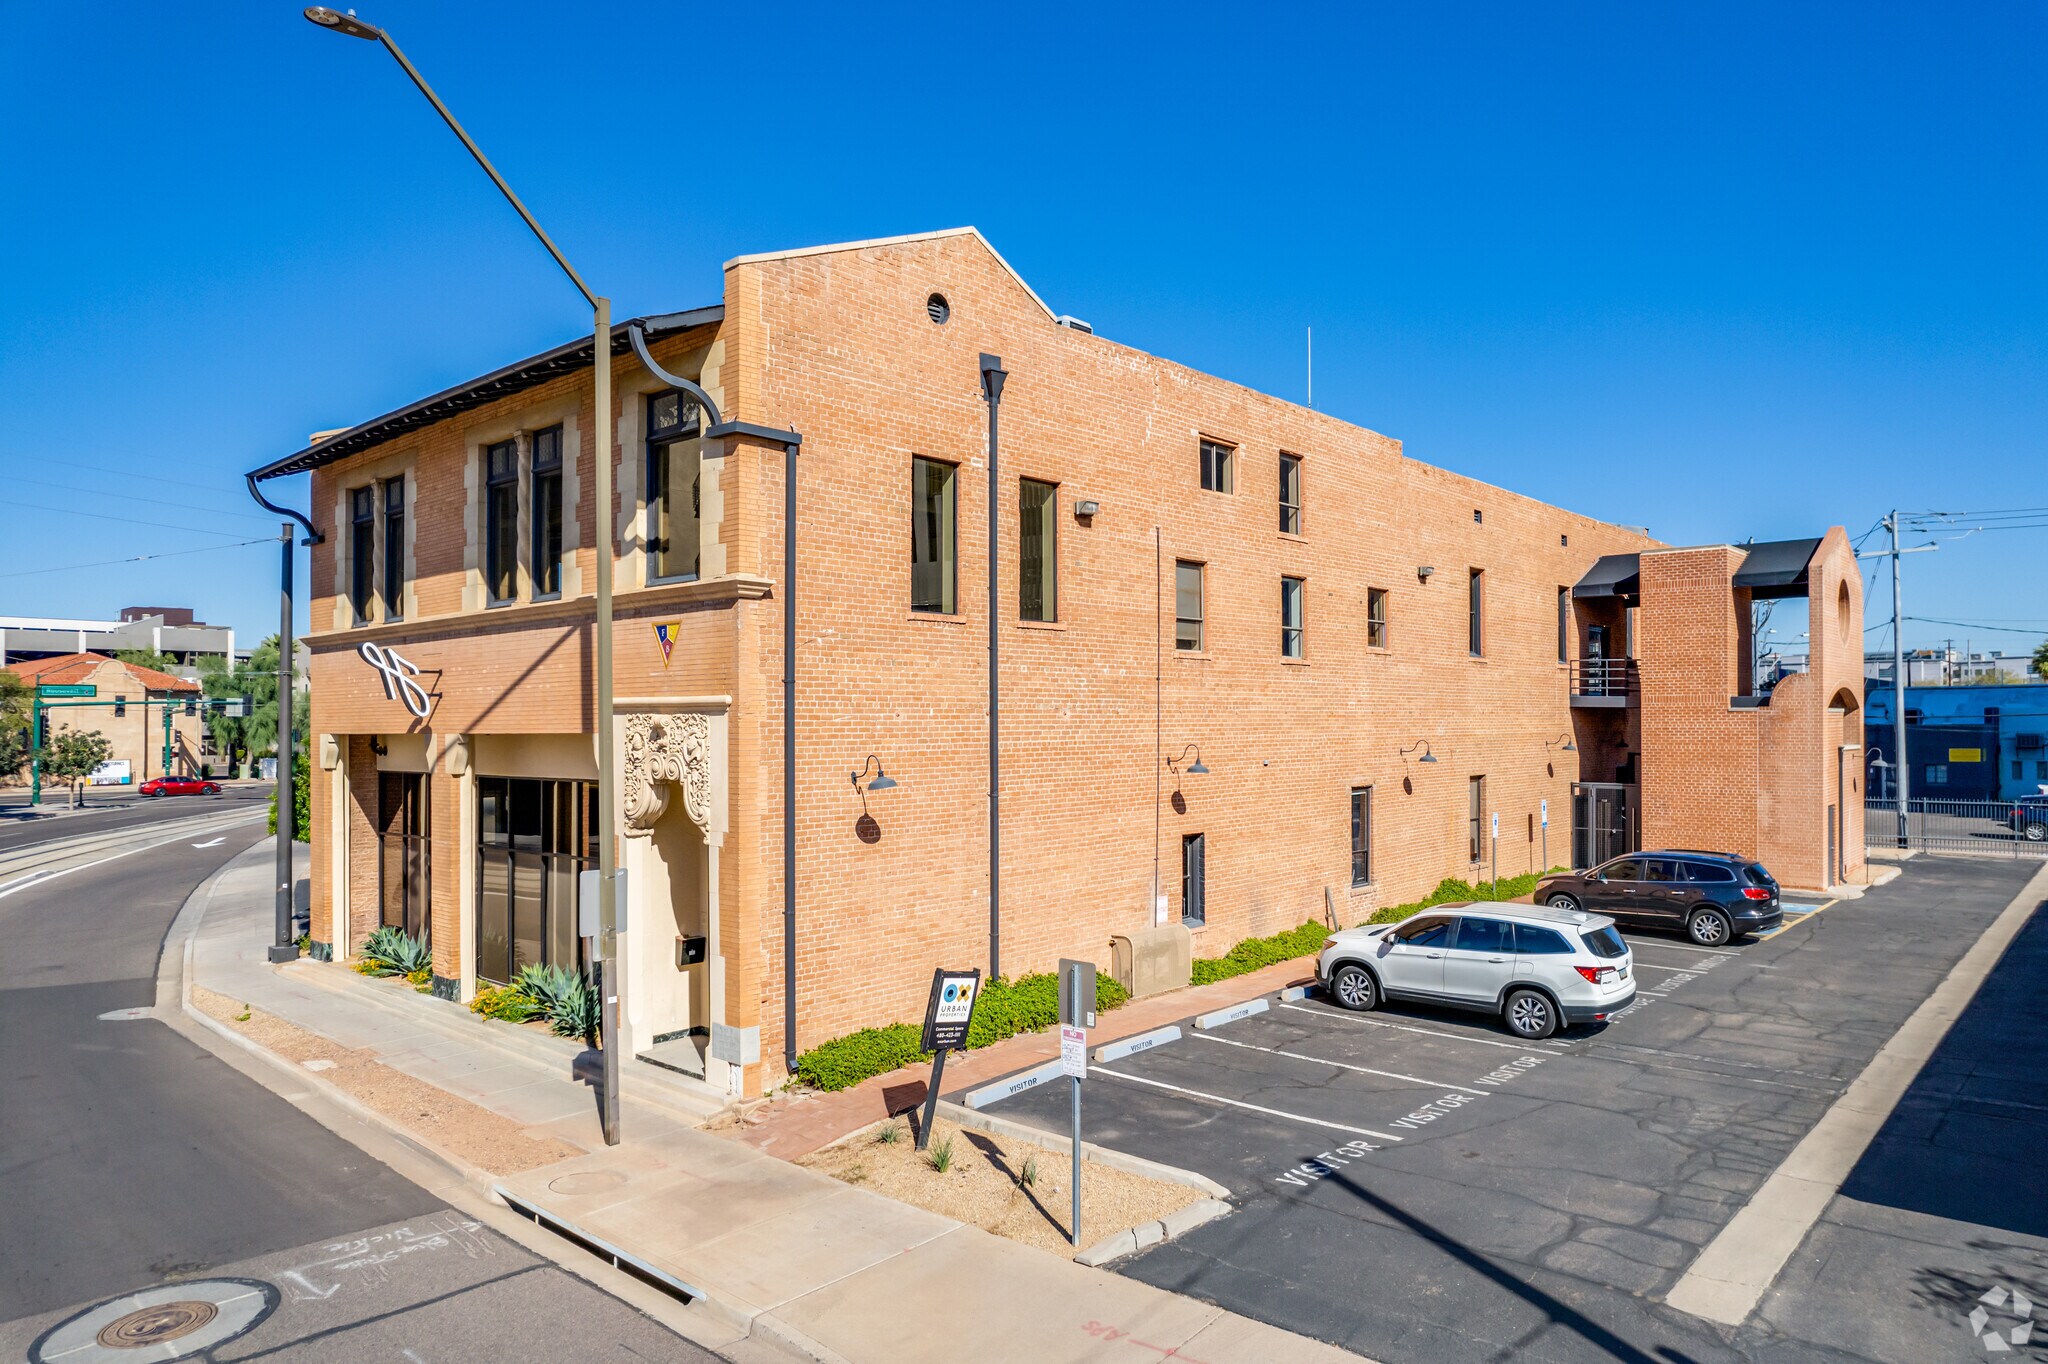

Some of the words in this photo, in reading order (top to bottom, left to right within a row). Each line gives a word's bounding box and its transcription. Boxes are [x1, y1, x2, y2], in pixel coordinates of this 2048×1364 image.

[940, 1005, 968, 1013] URBAN
[1230, 1009, 1249, 1020] VISITOR
[1130, 1039, 1153, 1052] VISITOR
[1473, 1055, 1547, 1087] VISITOR
[1009, 1077, 1038, 1094] VISITOR
[1389, 1093, 1475, 1130] VISITOR
[1275, 1140, 1381, 1187] VISITOR
